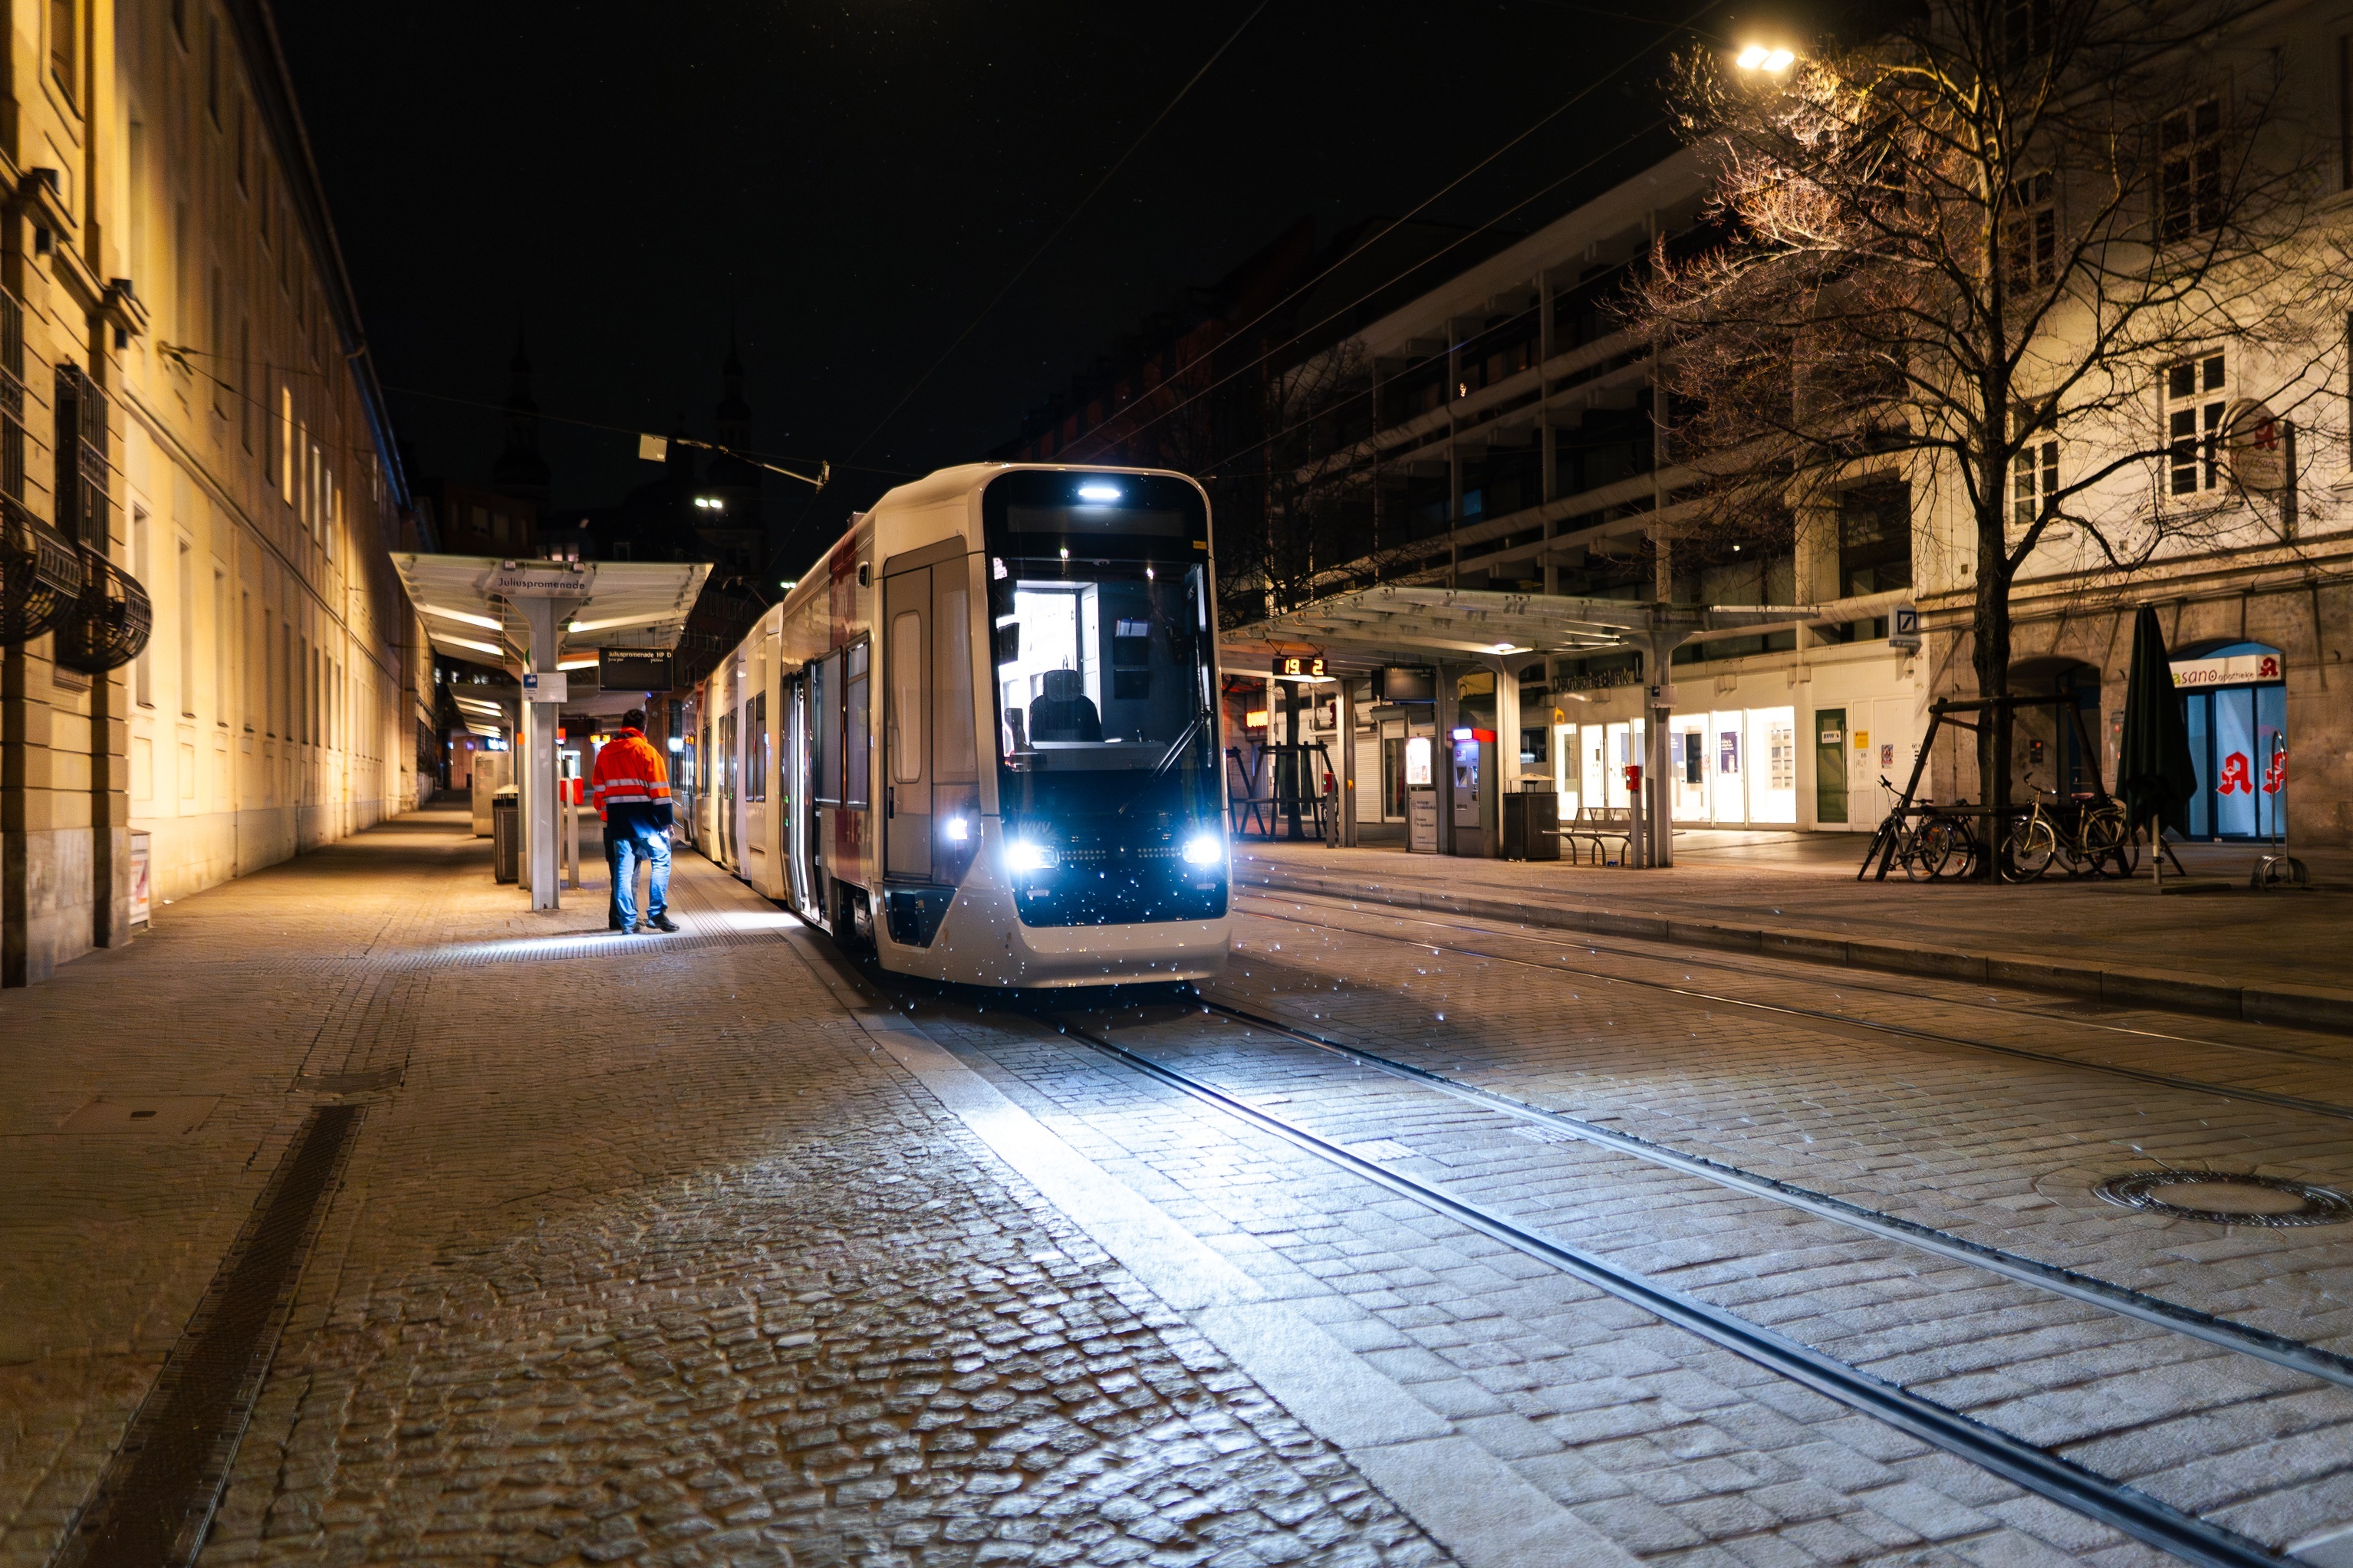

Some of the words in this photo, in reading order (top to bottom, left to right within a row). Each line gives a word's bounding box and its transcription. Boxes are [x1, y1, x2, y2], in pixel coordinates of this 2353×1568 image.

[499, 577, 585, 590] Juliuspromenade
[1285, 659, 1300, 675] 19
[1312, 659, 1324, 676] 2
[1554, 672, 1601, 692] Deutsche
[1602, 667, 1631, 687] Bank
